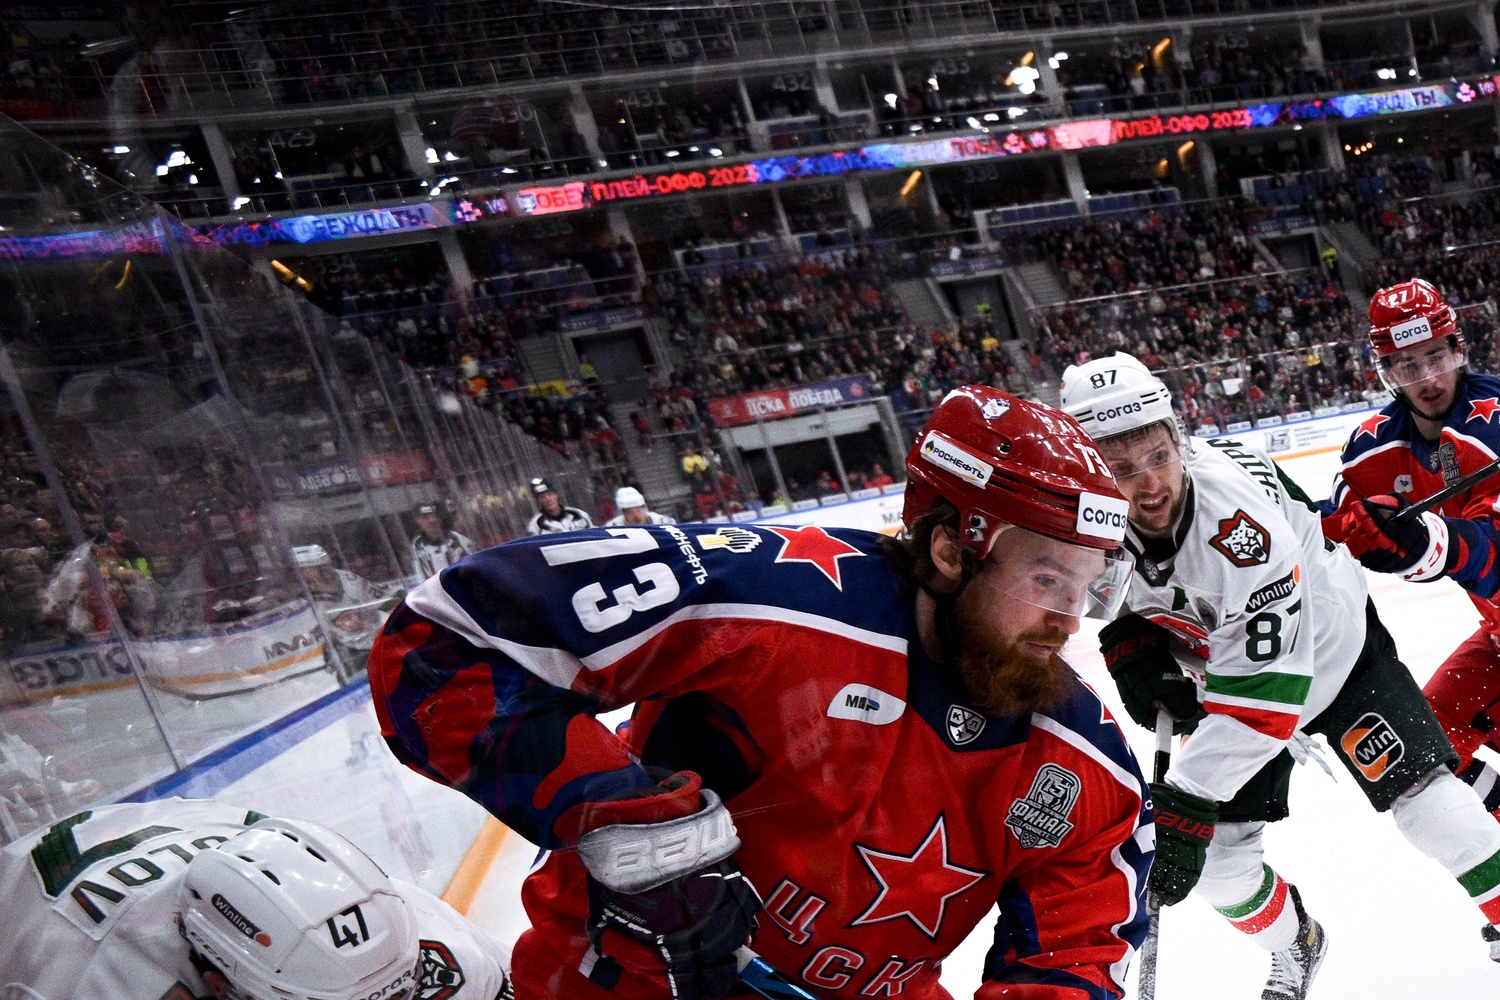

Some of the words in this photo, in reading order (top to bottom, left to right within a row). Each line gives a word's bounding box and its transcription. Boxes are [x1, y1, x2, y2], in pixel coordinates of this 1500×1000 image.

[1114, 113, 1209, 138] ПЛЕЙ-ОФФ
[1211, 108, 1252, 129] 2023
[591, 170, 706, 200] ПЛЕЙ-ОФФ
[708, 164, 757, 187] 2023
[1387, 289, 1408, 307] 27
[1394, 323, 1430, 342] согаз
[1089, 369, 1118, 390] 87
[789, 387, 844, 410] ПОБЕДА
[1097, 401, 1142, 422] согаз
[932, 446, 985, 481] РОСНЕФТЬ
[1072, 441, 1113, 479] 73
[1083, 505, 1127, 530] согаз
[540, 527, 681, 634] 73
[1356, 727, 1396, 762] Win
[1012, 802, 1070, 837] ФИНАЛ
[608, 812, 738, 871] BAU
[214, 895, 253, 936] Winline
[326, 903, 370, 950] 47
[764, 878, 936, 998] ЦСК
